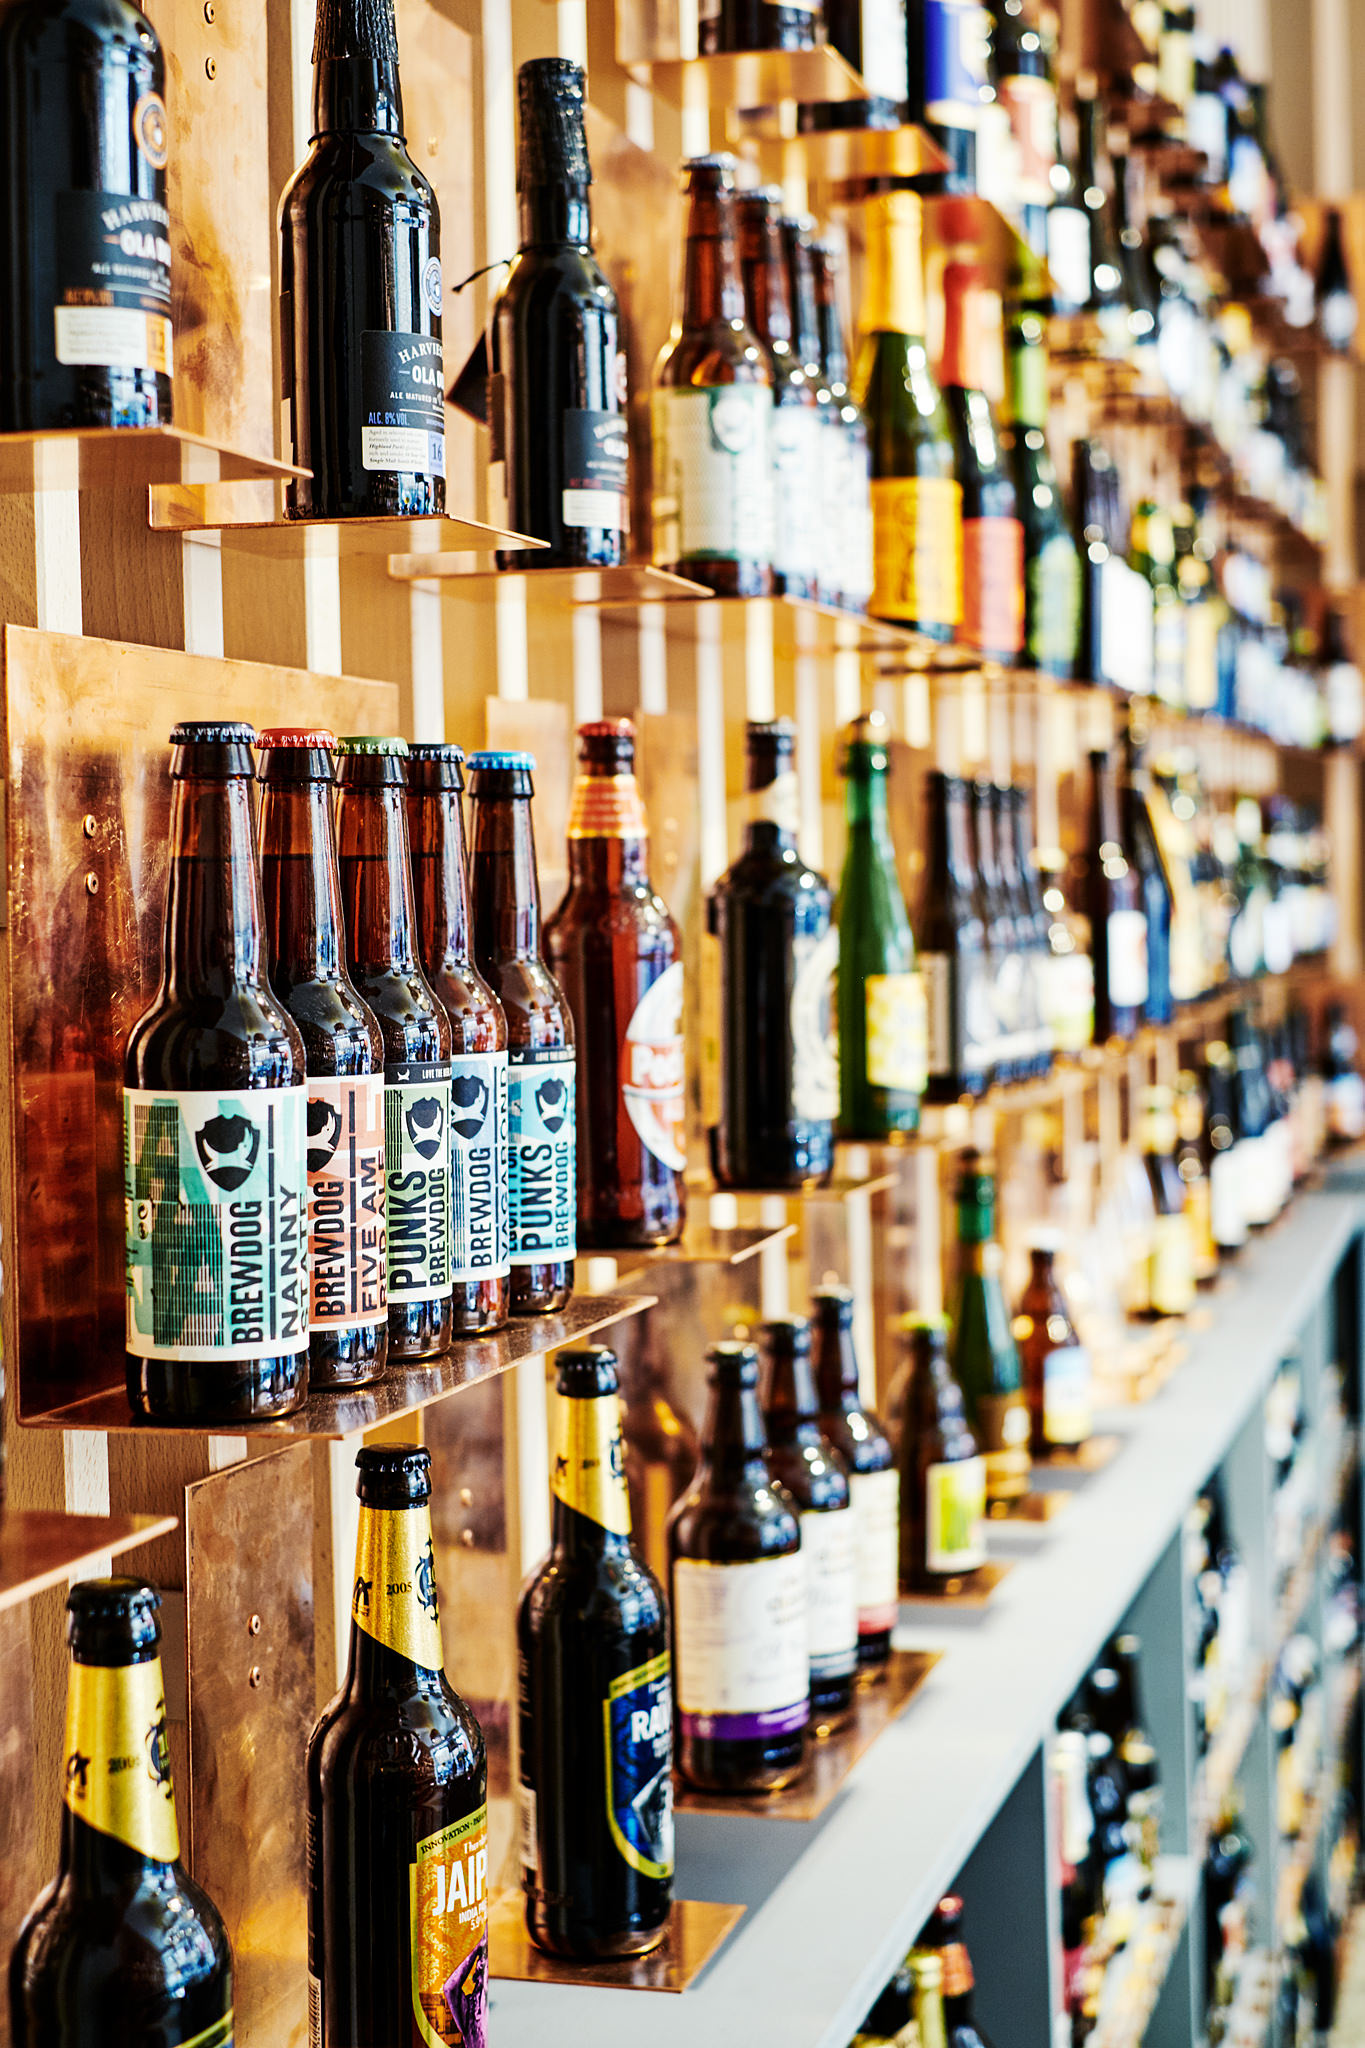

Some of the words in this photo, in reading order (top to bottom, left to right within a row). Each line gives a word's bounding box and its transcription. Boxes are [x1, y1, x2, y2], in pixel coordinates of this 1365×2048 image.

[368, 411, 384, 425] ALC.
[390, 391, 403, 400] ALE
[412, 365, 436, 386] OLA
[432, 443, 443, 462] 16
[361, 1157, 377, 1214] AM
[388, 1171, 427, 1290] PUNKS
[428, 1168, 446, 1287] BREWDOG
[469, 1147, 492, 1268] BREWDOG
[520, 1144, 553, 1251] PUNKS
[555, 1142, 569, 1248] BREWDOG
[230, 1201, 264, 1345] BREWDOG
[279, 1185, 299, 1339] NANNY
[299, 1191, 309, 1334] STATE
[313, 1181, 346, 1317] BREWDOG
[361, 1226, 377, 1312] FIVE
[386, 1581, 413, 1595] 2005
[420, 1821, 471, 1854] INNOVATION
[459, 1906, 478, 1924] INDIA
